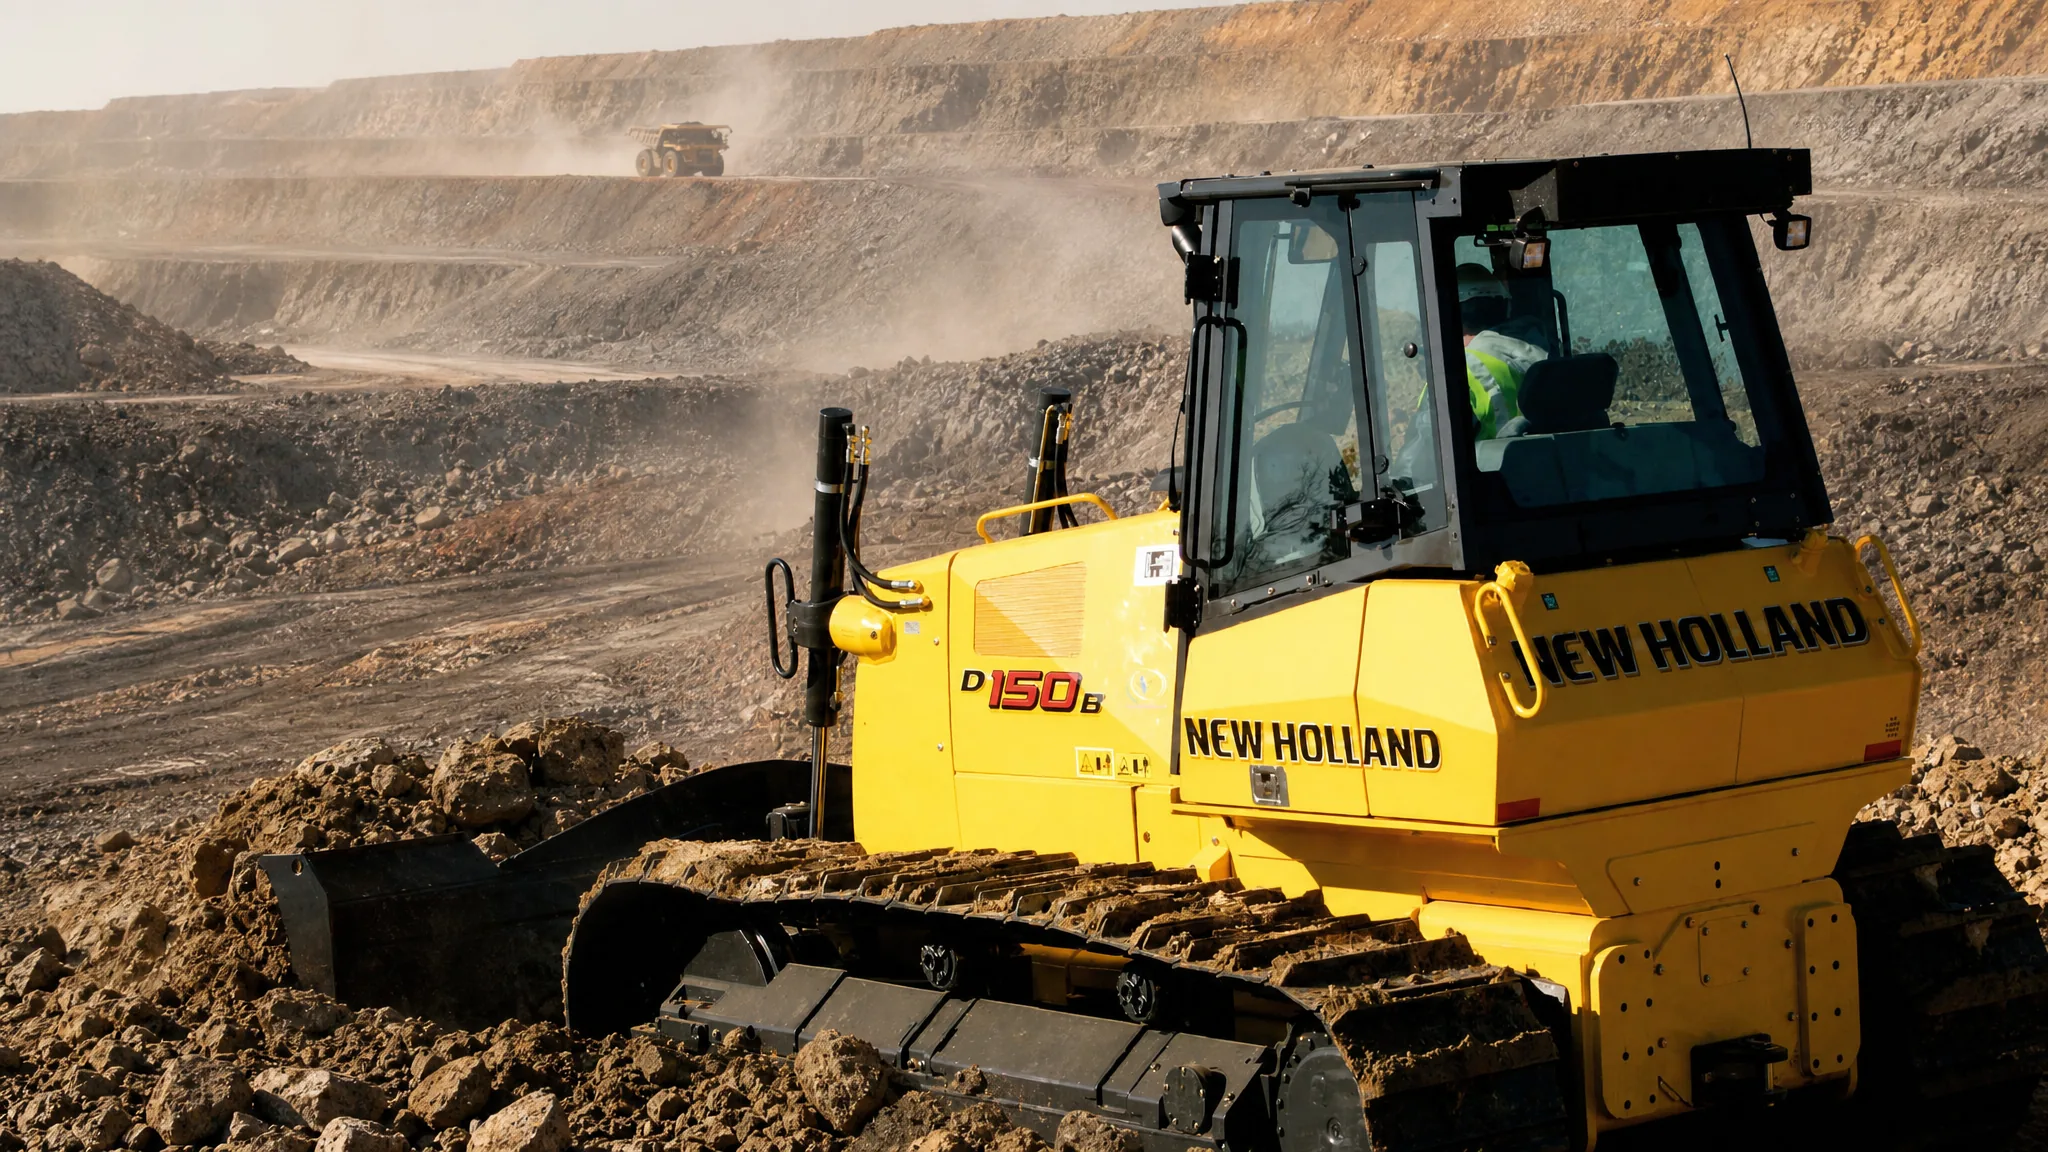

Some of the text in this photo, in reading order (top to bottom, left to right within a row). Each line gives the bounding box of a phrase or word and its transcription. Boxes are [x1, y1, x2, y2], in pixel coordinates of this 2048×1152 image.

[1511, 597, 1870, 690] NEW HOLLAND
[1184, 717, 1442, 772] NEW HOLLAND
